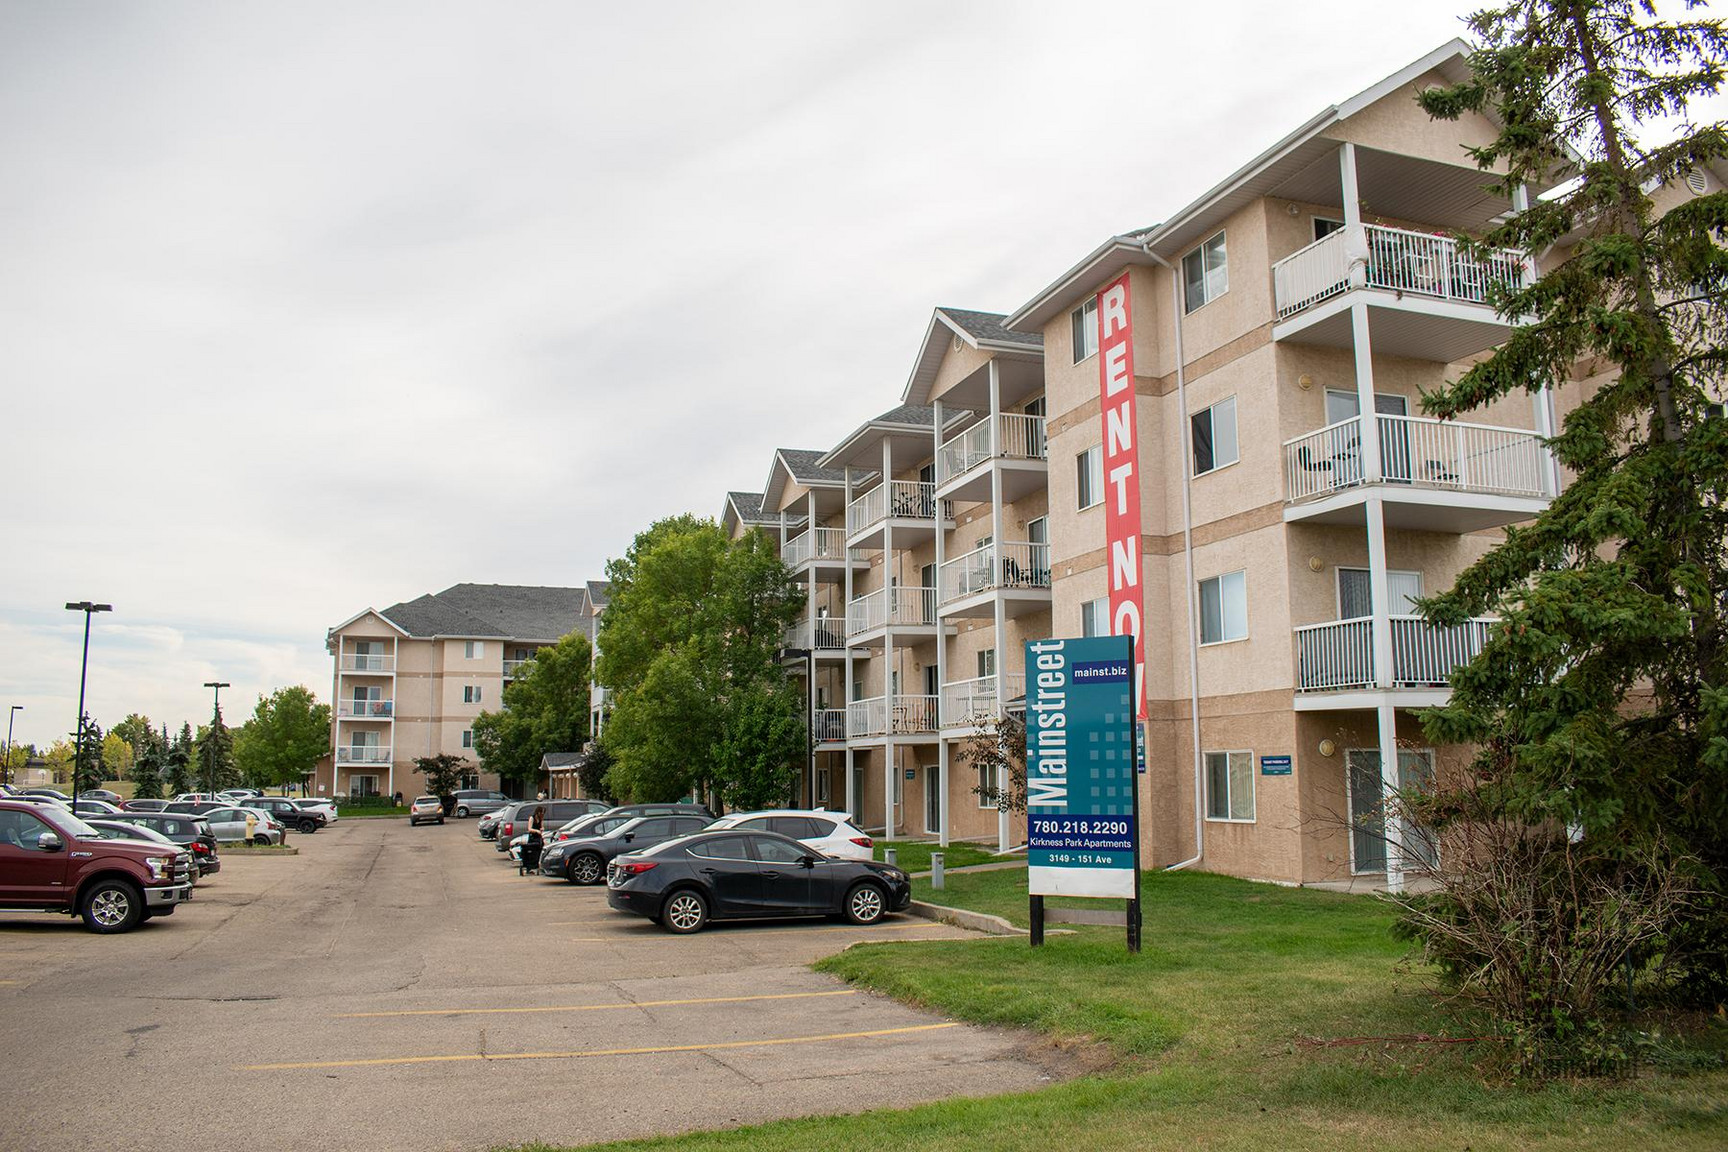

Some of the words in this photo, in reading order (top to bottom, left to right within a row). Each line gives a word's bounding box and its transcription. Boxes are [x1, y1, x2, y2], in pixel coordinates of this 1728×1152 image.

[1103, 284, 1132, 515] RENT
[1112, 535, 1144, 715] NO
[1074, 666, 1127, 677] mainst.biz
[1028, 640, 1068, 807] Mainstreet
[1033, 821, 1128, 834] 780.218.2290
[1030, 837, 1064, 847] Kirkness
[1065, 838, 1082, 847] Park
[1083, 838, 1132, 849] Apartments
[1049, 854, 1070, 863] 3149
[1078, 855, 1092, 863] 151
[1095, 856, 1112, 864] Ave
